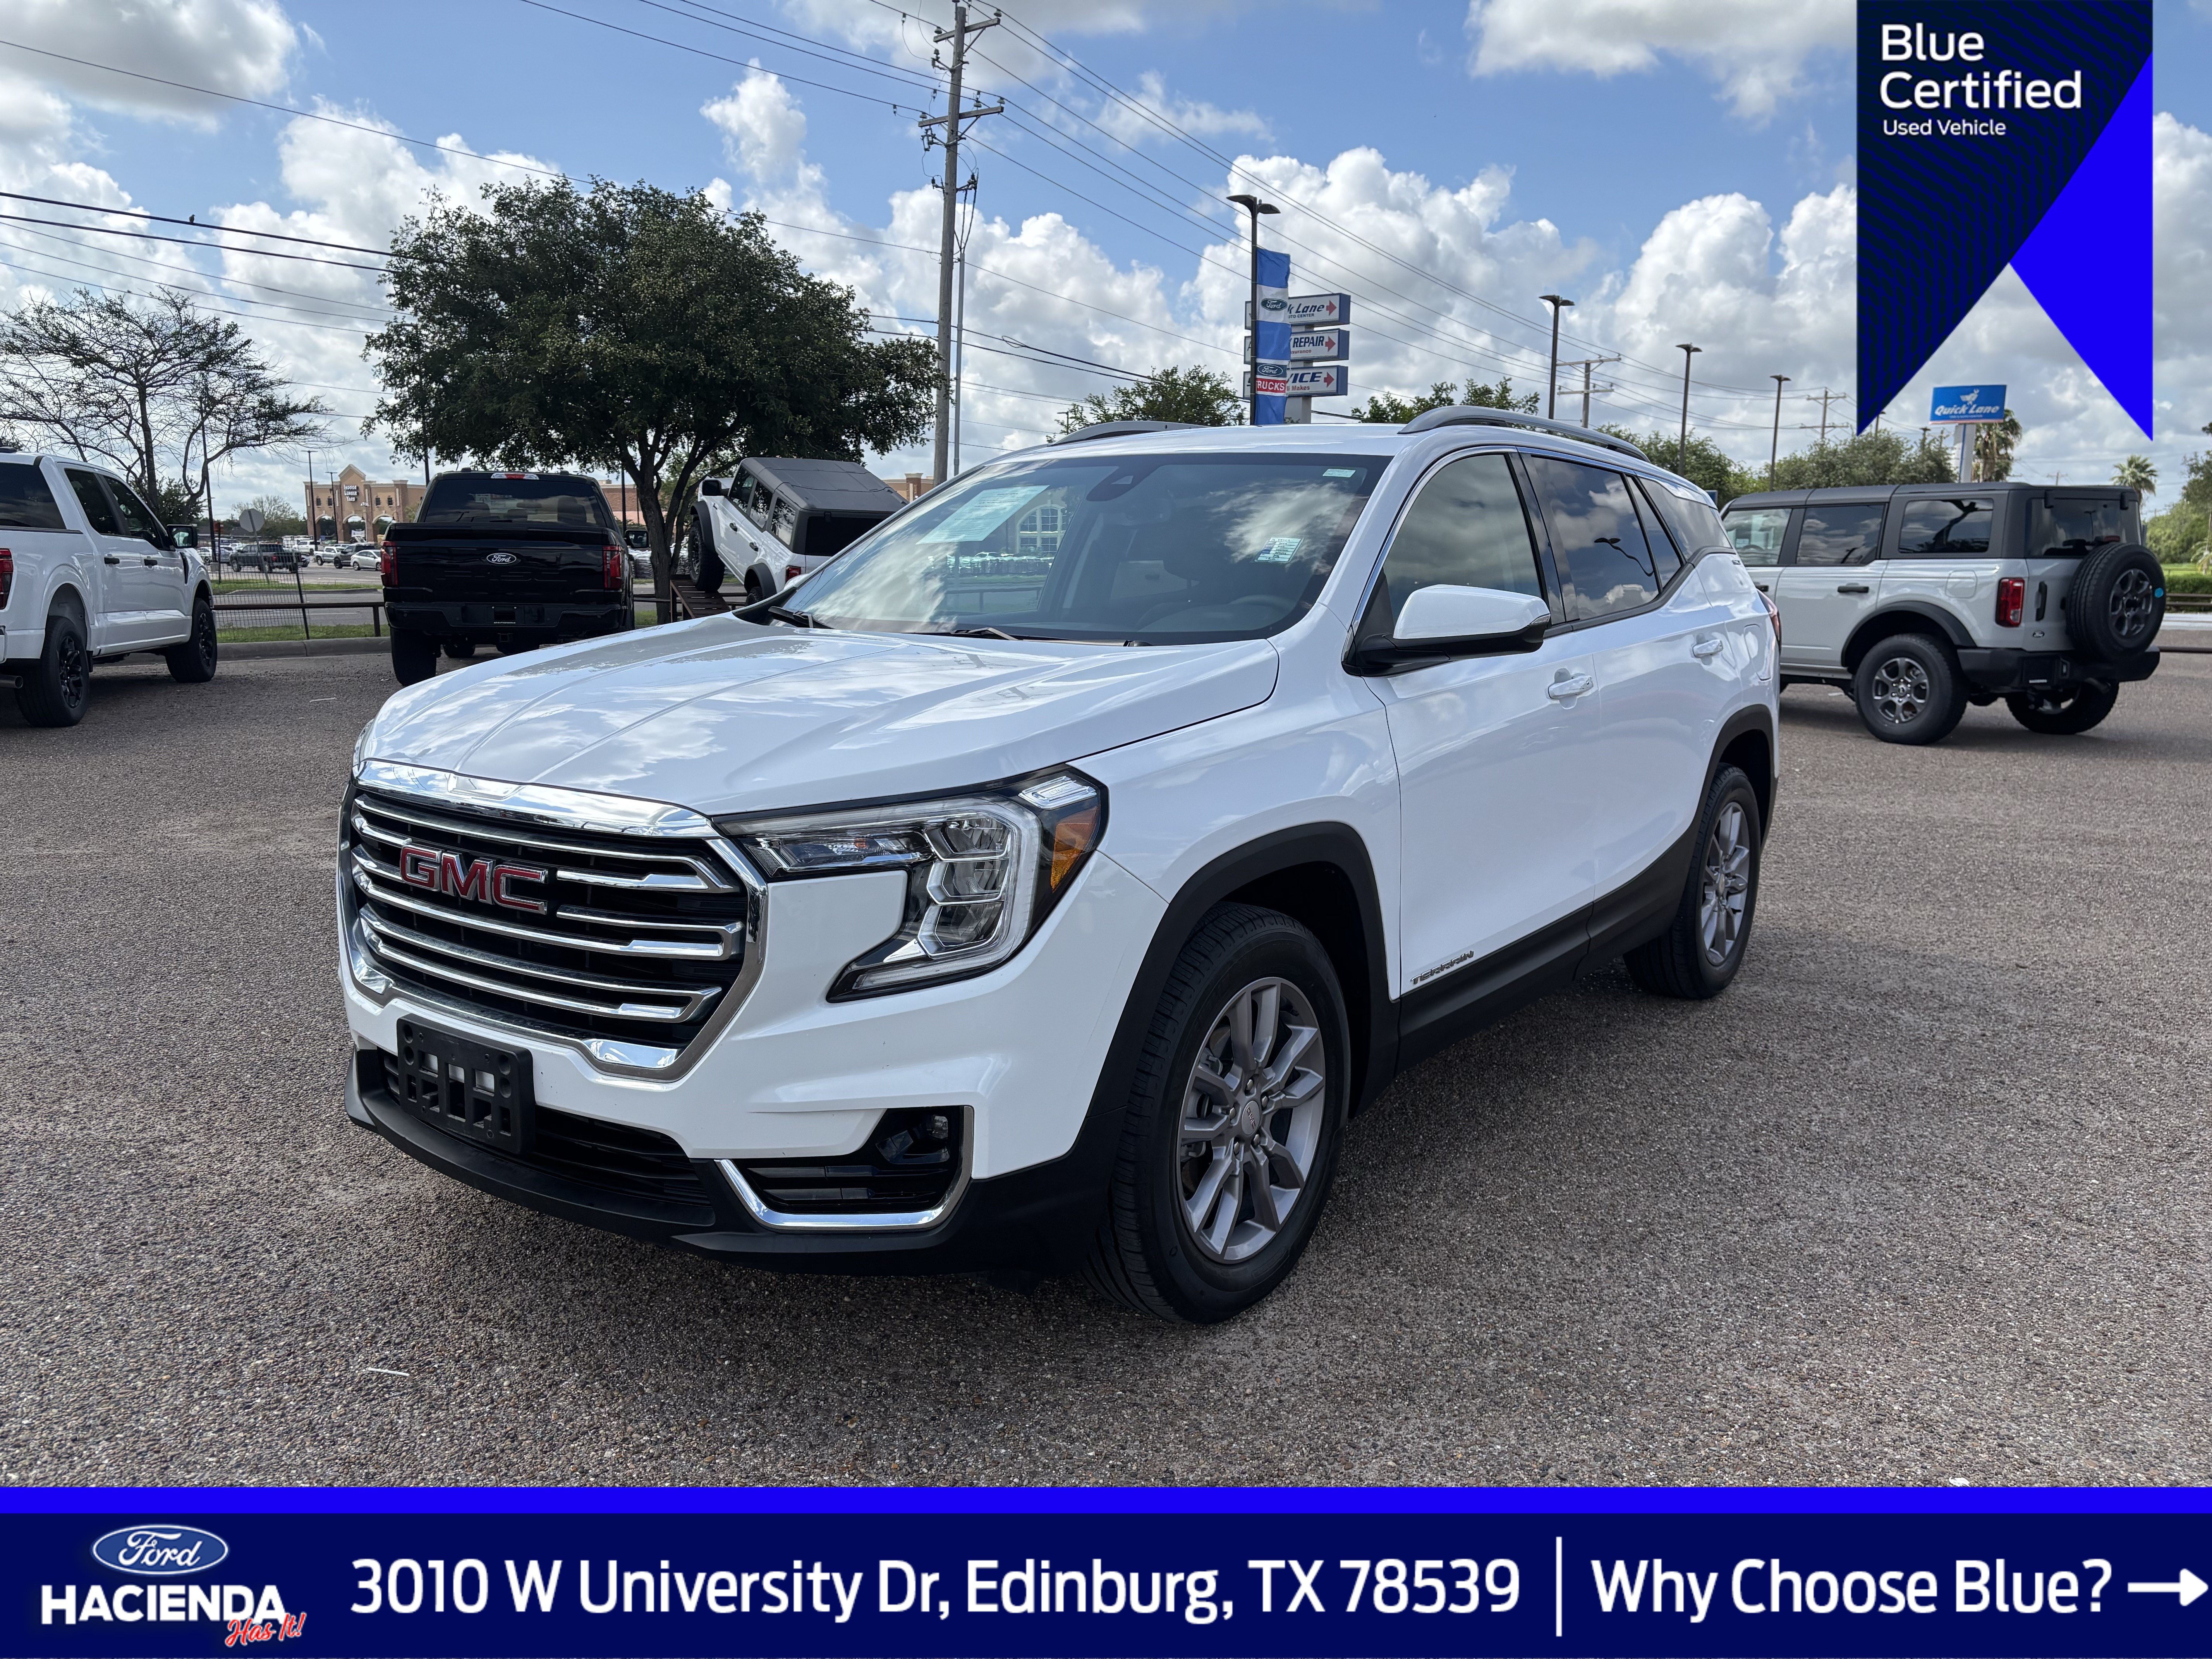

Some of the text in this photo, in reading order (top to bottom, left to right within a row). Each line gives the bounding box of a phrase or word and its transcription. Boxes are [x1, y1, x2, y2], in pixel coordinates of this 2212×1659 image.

[1266, 300, 1283, 309] Ford
[1295, 303, 1324, 313] Lane
[1292, 336, 1324, 348] REPAIR
[1262, 366, 1278, 374] Ford
[1256, 380, 1285, 391] RUCKS
[1935, 404, 2000, 416] Quick Lane
[491, 554, 511, 562] Ford
[1049, 785, 1072, 795] GMC
[400, 843, 548, 915] GMC
[1410, 950, 1474, 985] TERRAIN
[1247, 1106, 1256, 1129] GMC
